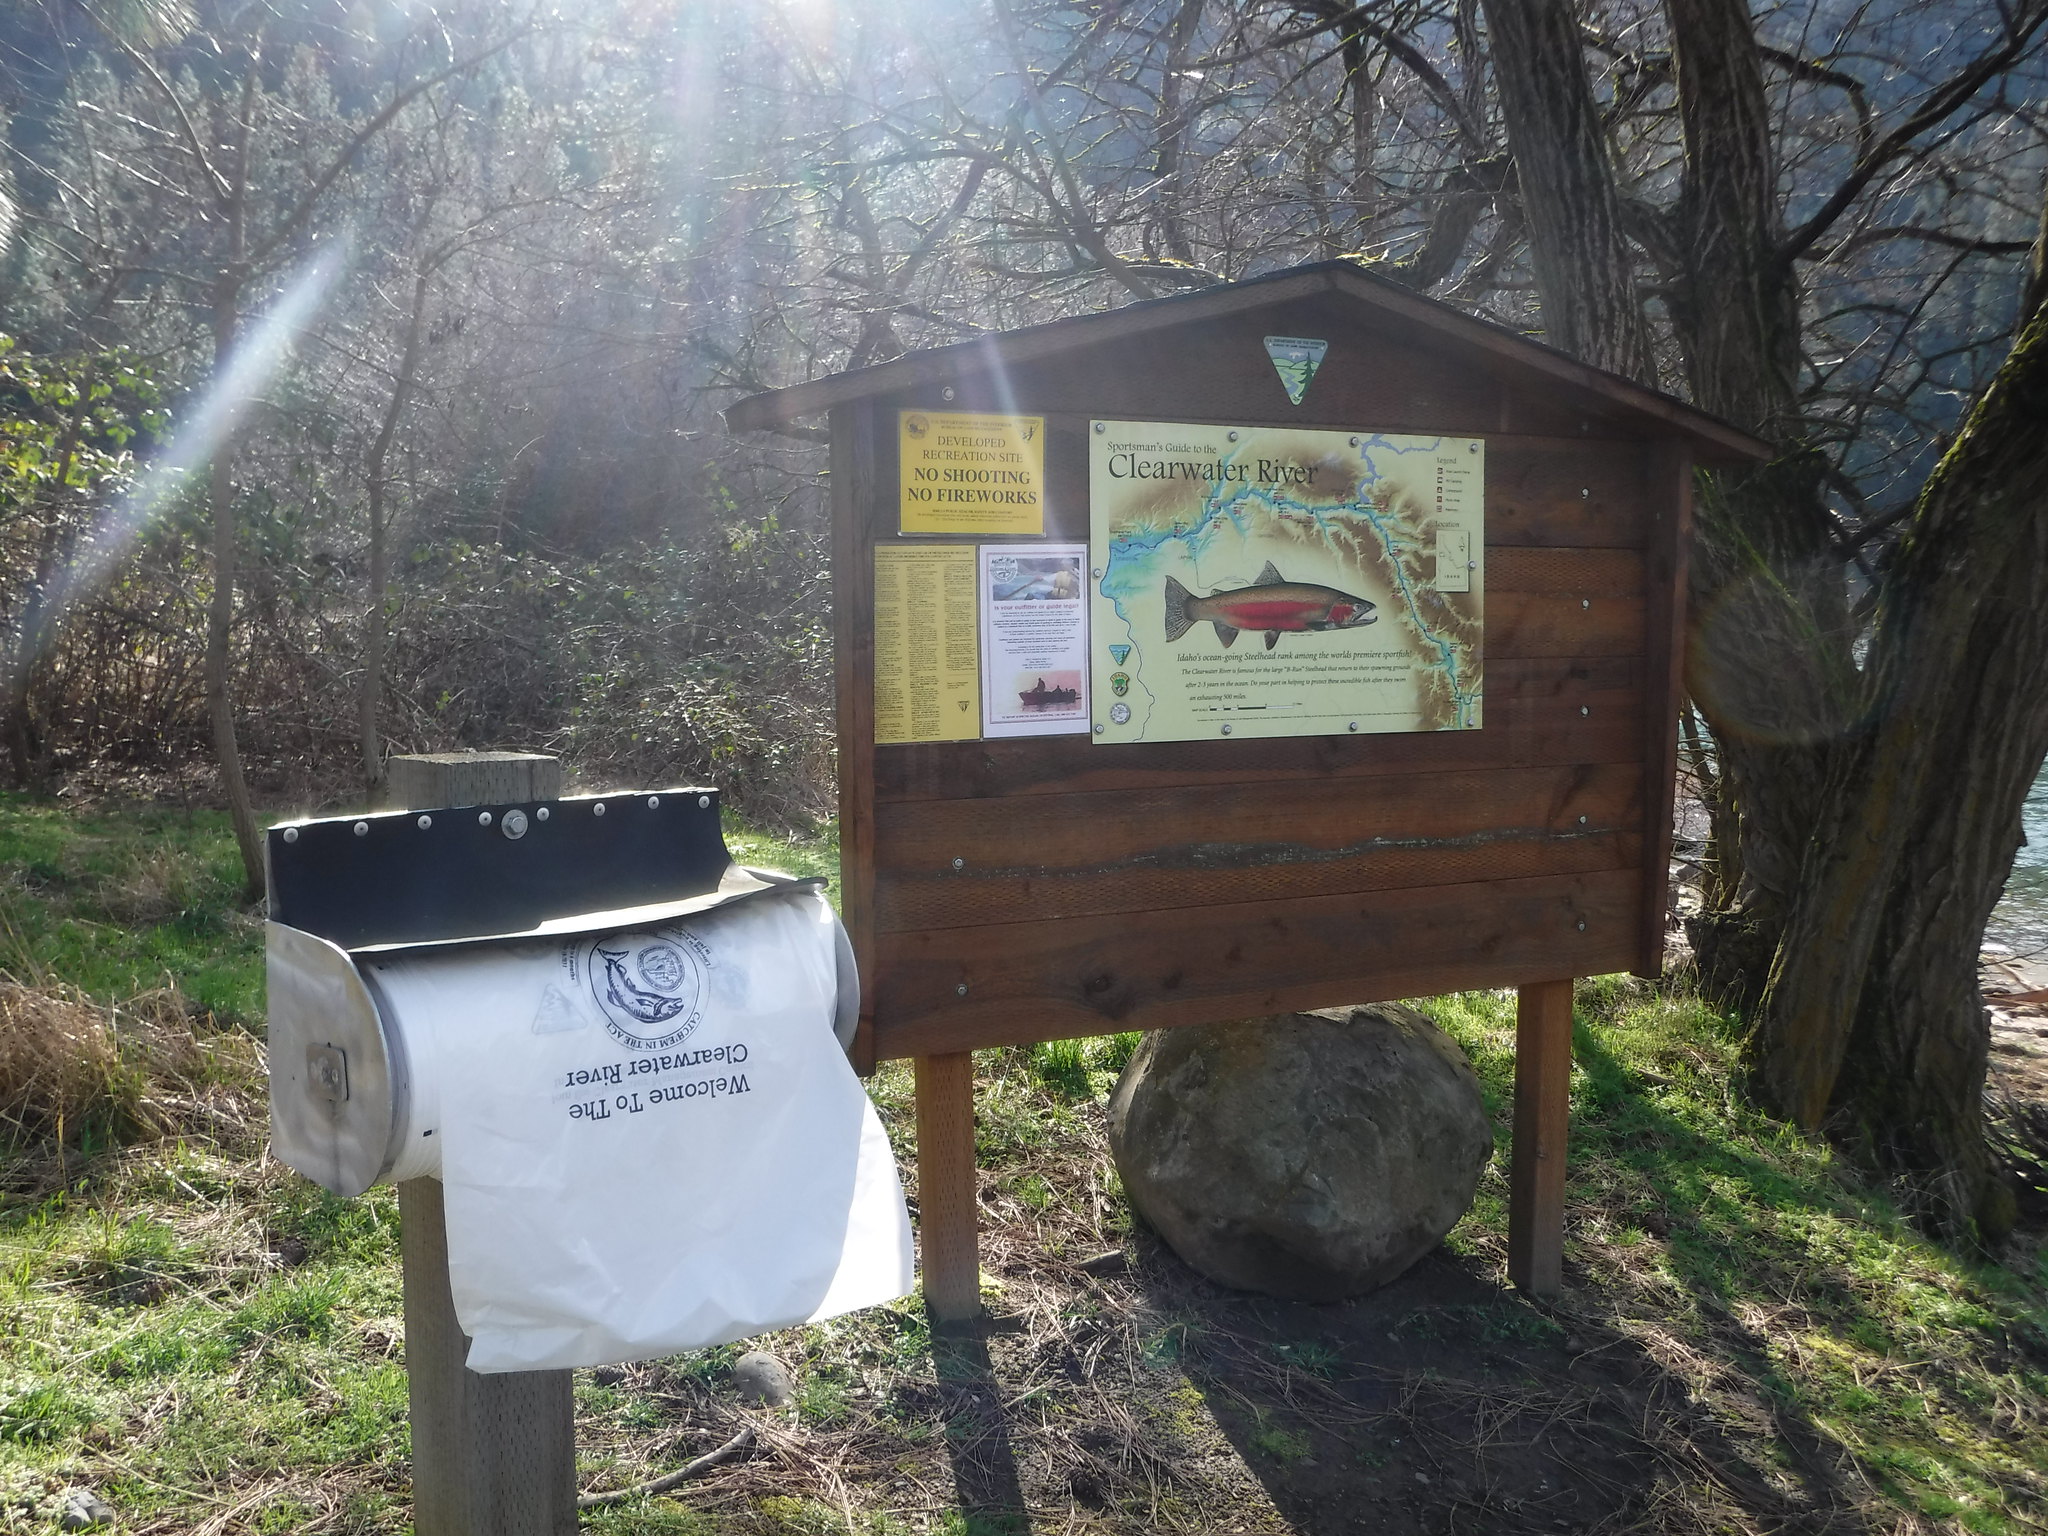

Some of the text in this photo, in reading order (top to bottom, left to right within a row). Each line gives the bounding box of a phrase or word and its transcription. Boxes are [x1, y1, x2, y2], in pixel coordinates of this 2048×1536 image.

[938, 436, 1005, 448] DEVELOPED
[1107, 440, 1216, 454] Sportsman's Guide to the
[923, 450, 1023, 463] RECREATION SITE
[914, 468, 1030, 484] NO SHOOTING
[1108, 453, 1318, 484] Clearwater River
[908, 488, 1036, 504] NO FIREWORKS
[1177, 653, 1201, 662] Idaho's
[1203, 653, 1242, 663] ocean-going
[1244, 652, 1276, 661] Steelhead
[1278, 652, 1293, 660] rank
[1295, 652, 1317, 660] among
[1353, 651, 1382, 660] premiere
[1383, 650, 1412, 659] sportfish!
[605, 1022, 624, 1040] ACT
[624, 1035, 643, 1049] THE
[645, 1041, 656, 1050] IN
[565, 1043, 748, 1088] Clearwater River
[569, 1074, 751, 1121] Welcome To The
